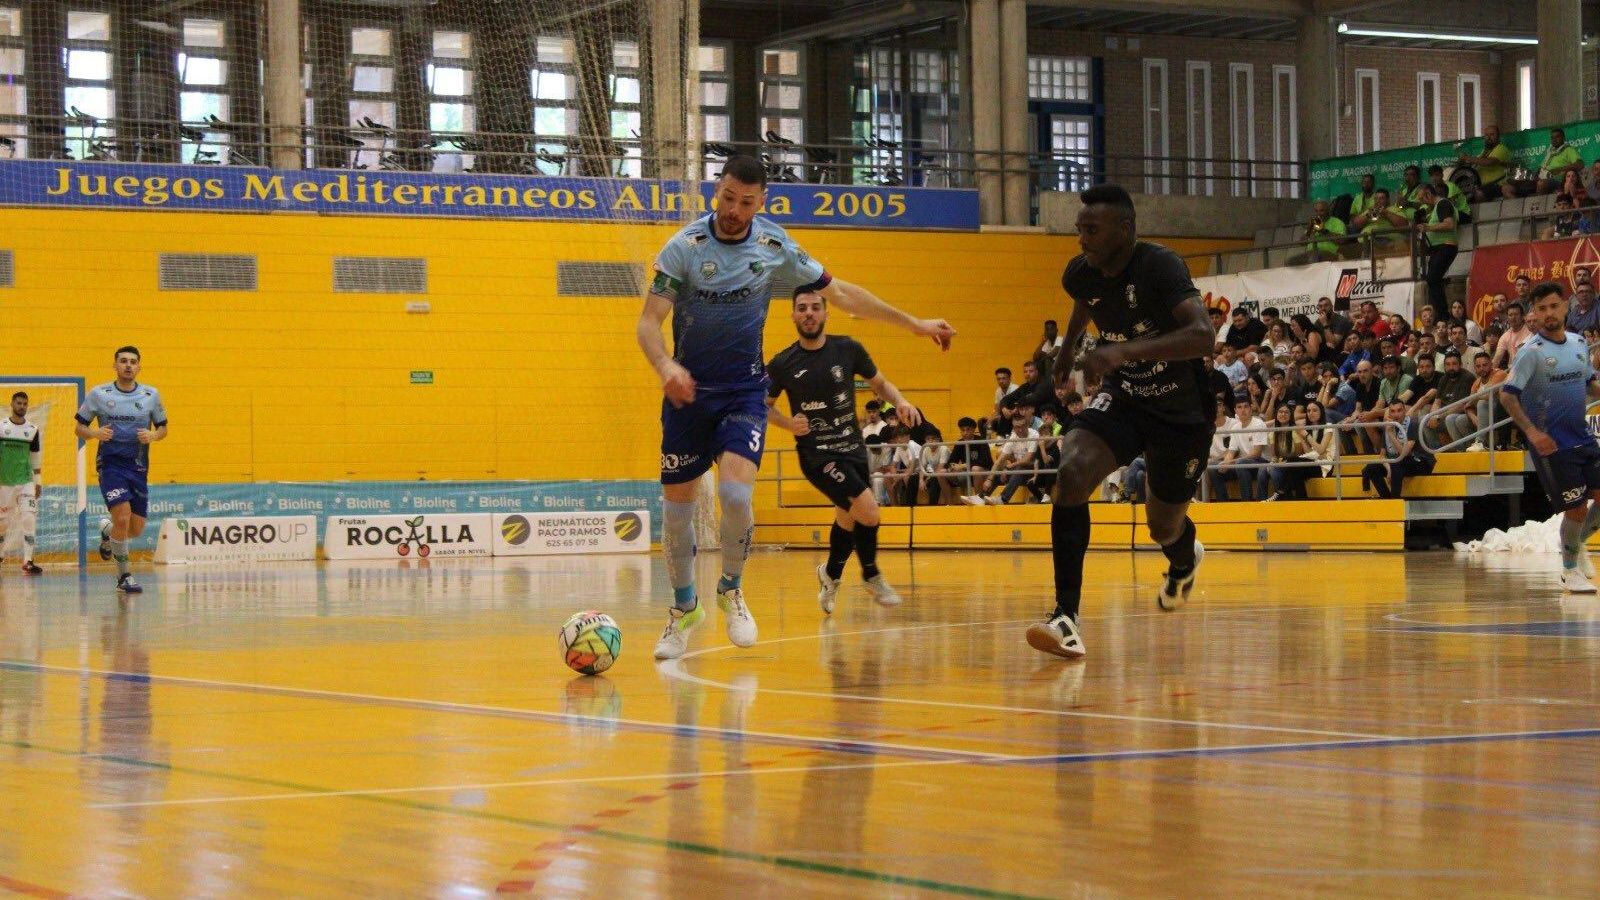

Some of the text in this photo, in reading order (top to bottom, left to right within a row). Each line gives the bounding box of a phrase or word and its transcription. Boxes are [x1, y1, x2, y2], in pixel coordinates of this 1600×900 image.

[46, 168, 225, 205] Juegos
[243, 173, 597, 212] Mediterraneos
[812, 190, 907, 219] 2005
[1263, 293, 1312, 308] EXCAVACIONES
[749, 429, 762, 453] 3
[829, 468, 846, 483] 5
[208, 500, 254, 511] Bioline
[279, 499, 324, 510] Bioline
[346, 497, 391, 509] Bioline
[413, 496, 457, 509] Bioline
[479, 496, 522, 508] Bioline
[544, 496, 585, 508] Bioline
[607, 496, 648, 507] Bioline
[338, 518, 367, 526] Frutas
[538, 517, 607, 528] NEUMÁTICOS
[347, 524, 475, 547] ROCALLA
[538, 528, 608, 538] PACO RAMOS
[576, 539, 586, 547] 07
